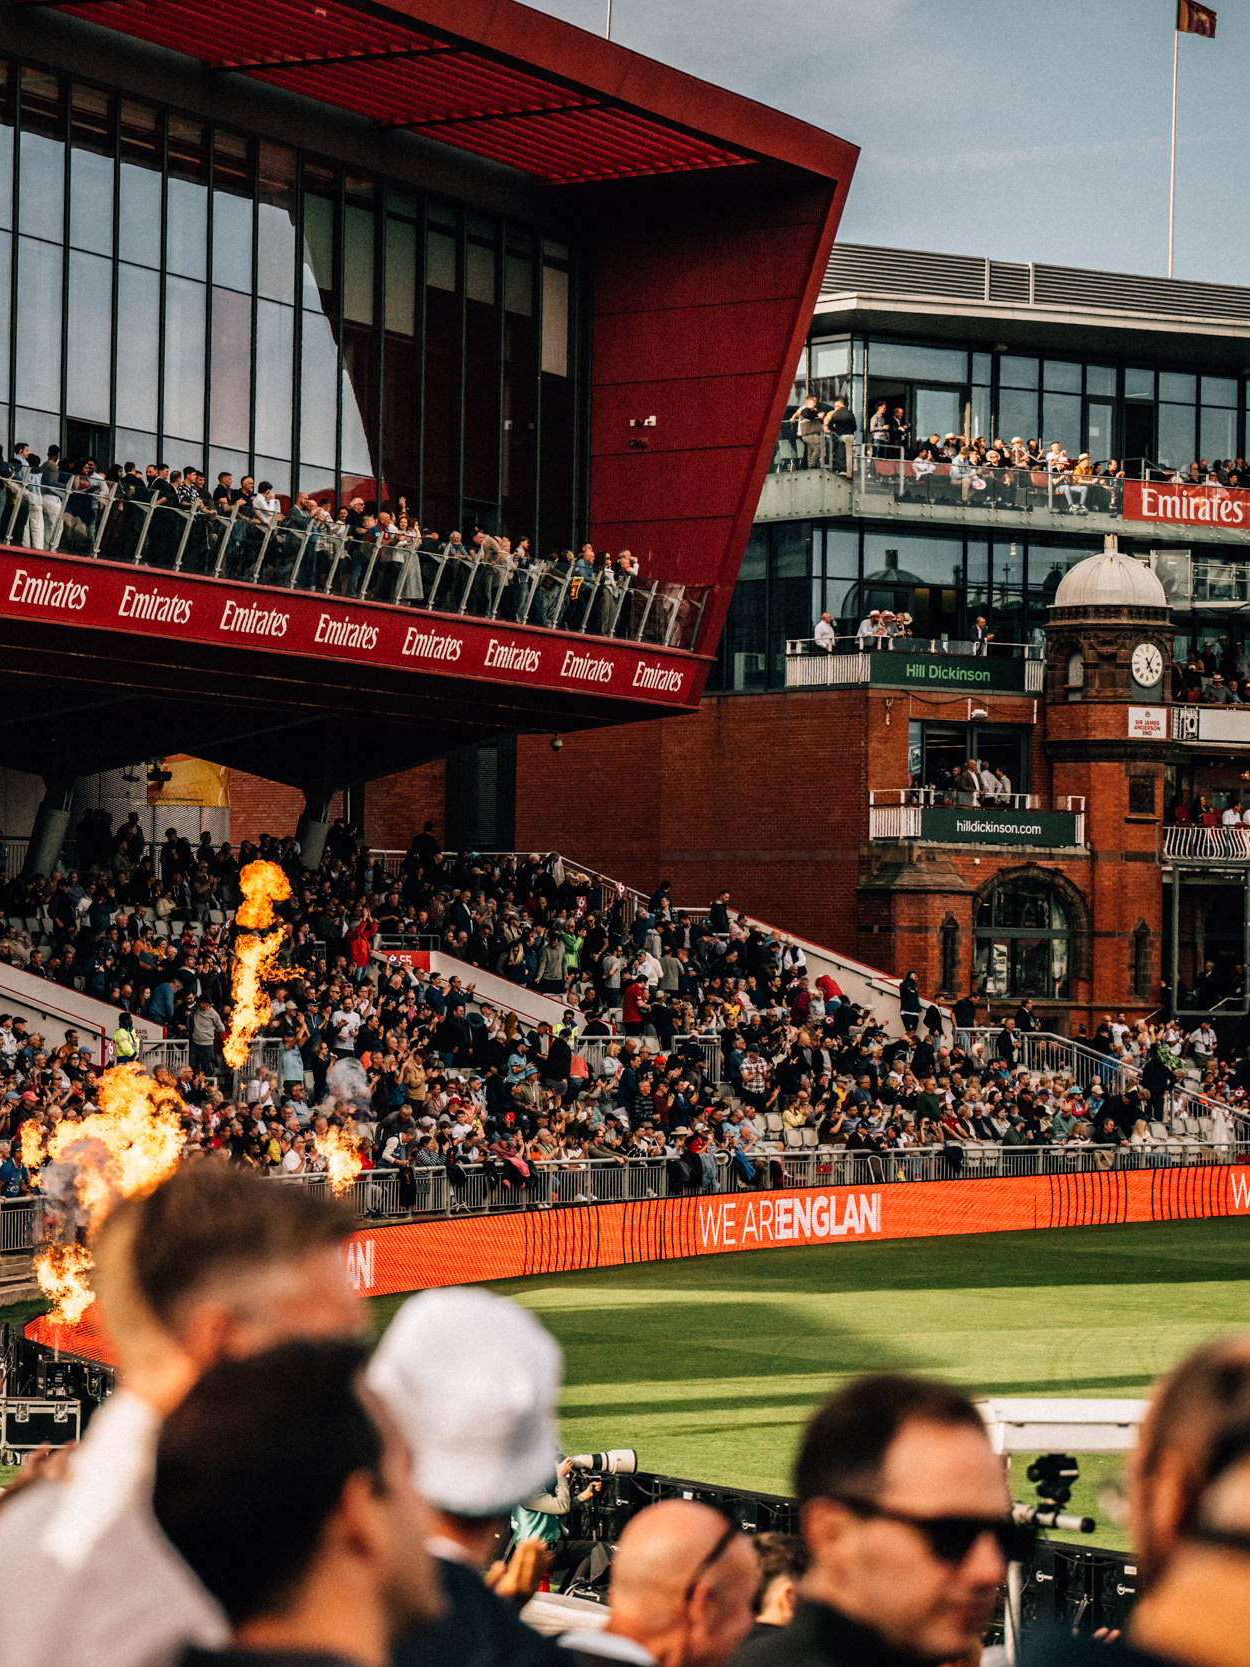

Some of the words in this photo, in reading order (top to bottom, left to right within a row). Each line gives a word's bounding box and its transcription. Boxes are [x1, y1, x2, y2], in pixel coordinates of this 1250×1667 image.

[1141, 488, 1244, 523] Emirates
[9, 569, 89, 610] Emirates
[118, 586, 193, 624] Emirates
[219, 599, 290, 637] Emirates
[314, 613, 380, 650] Emirates
[401, 626, 463, 661] Emirates
[483, 639, 542, 673] Emirates
[560, 650, 616, 683] Emirates
[632, 661, 684, 692] Emirates
[906, 663, 925, 678] Hill
[928, 665, 991, 682] Dickinson
[956, 819, 1042, 835] hilldickinson.com
[699, 1203, 736, 1248] WE
[778, 1193, 882, 1240] ENGLAN
